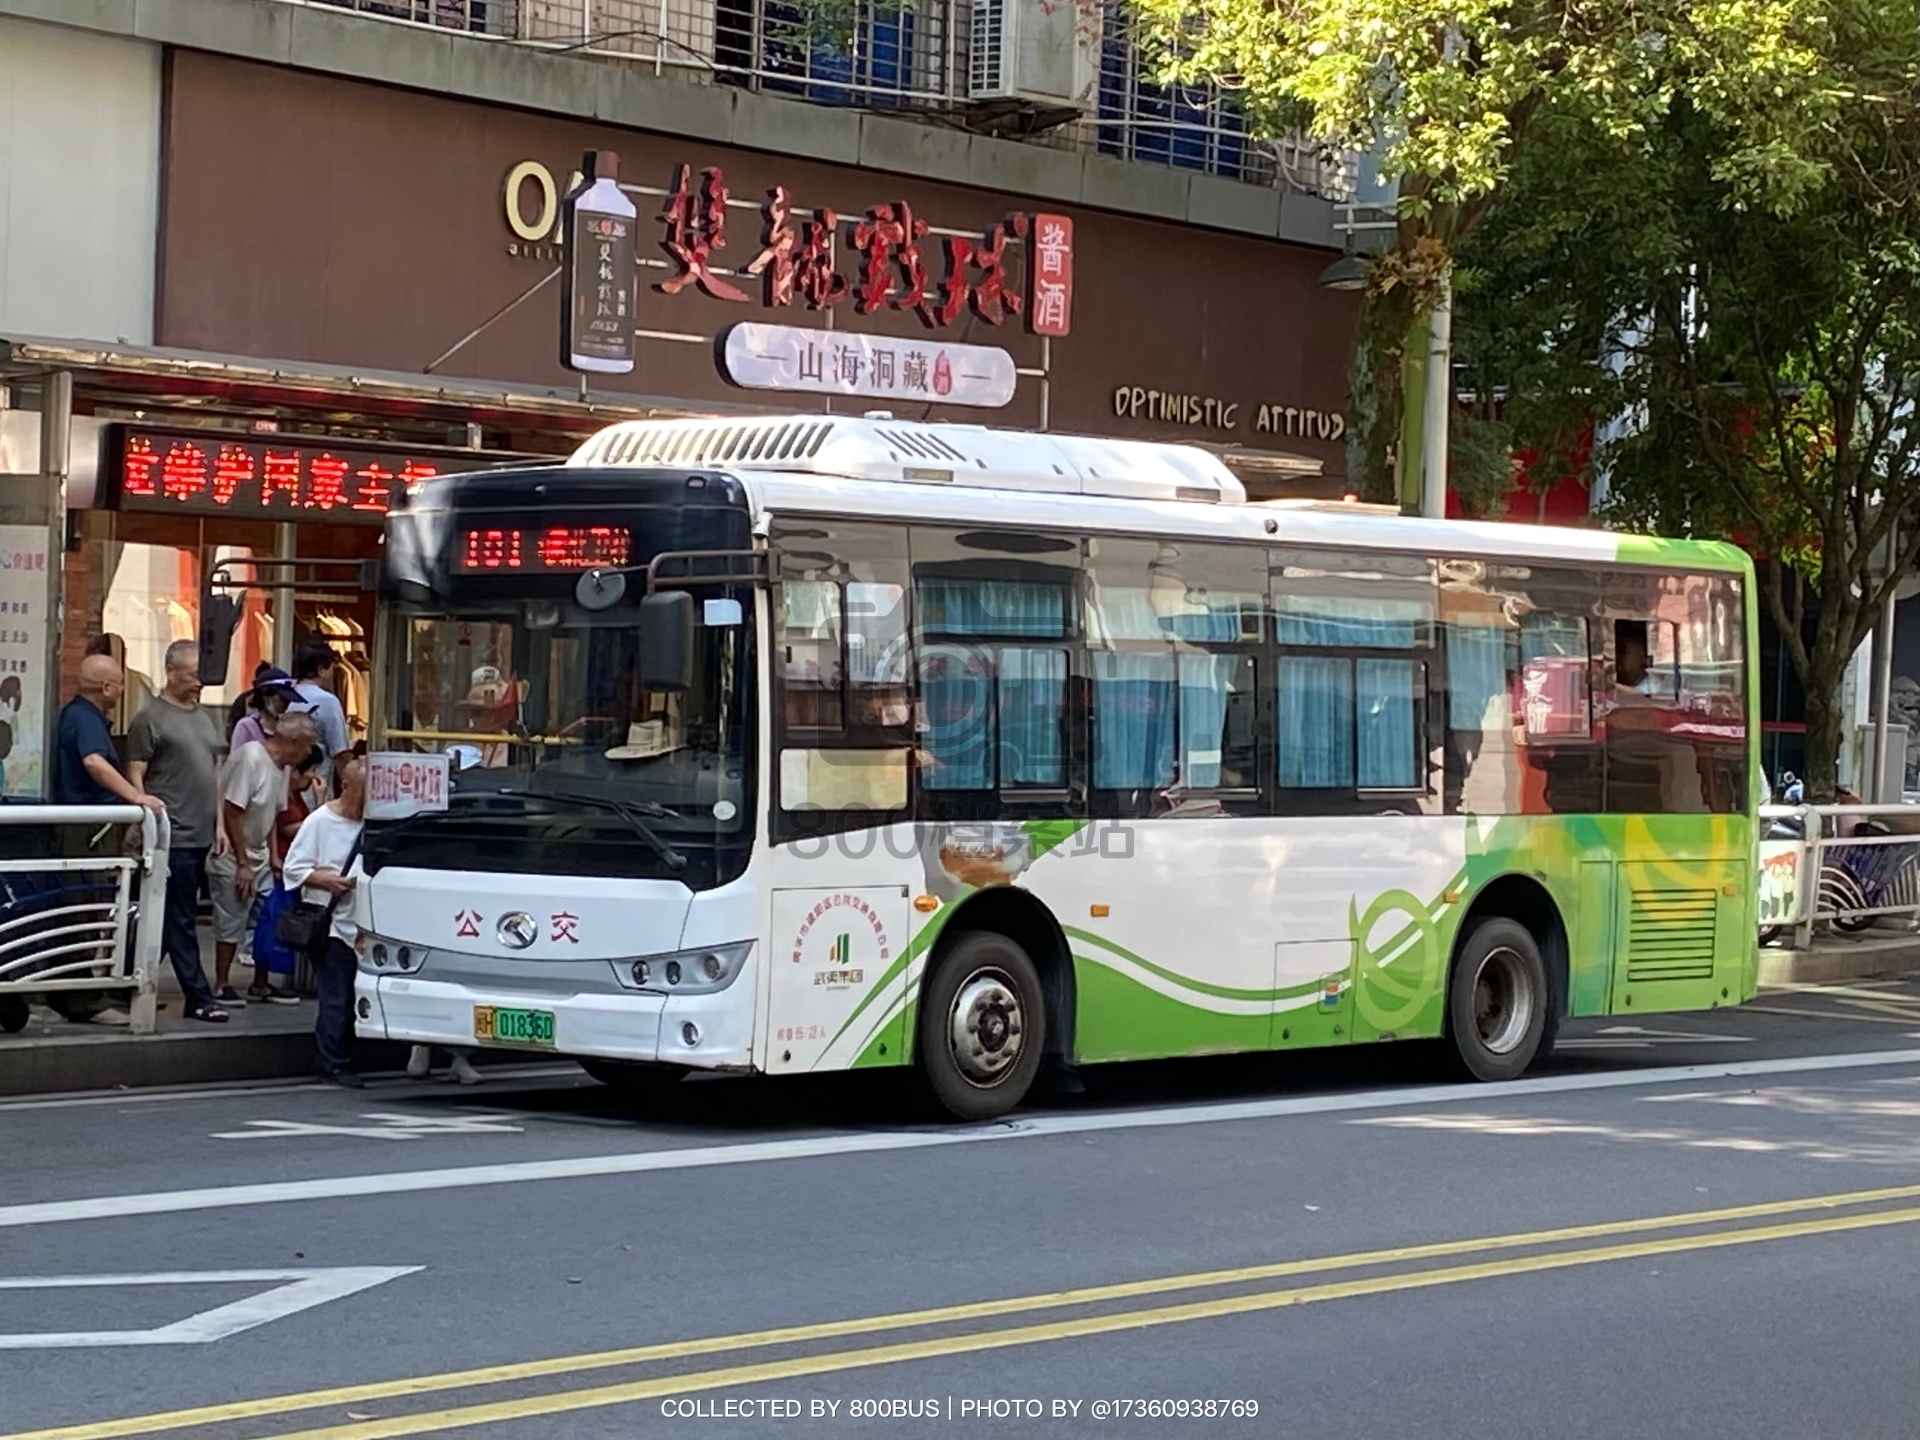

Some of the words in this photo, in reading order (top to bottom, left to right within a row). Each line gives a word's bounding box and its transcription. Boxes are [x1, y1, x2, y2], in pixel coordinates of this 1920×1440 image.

[799, 342, 929, 394] 山海洞藏
[1116, 386, 1239, 430] OPTIMISTIC
[454, 909, 483, 939] 公
[550, 911, 580, 944] 交
